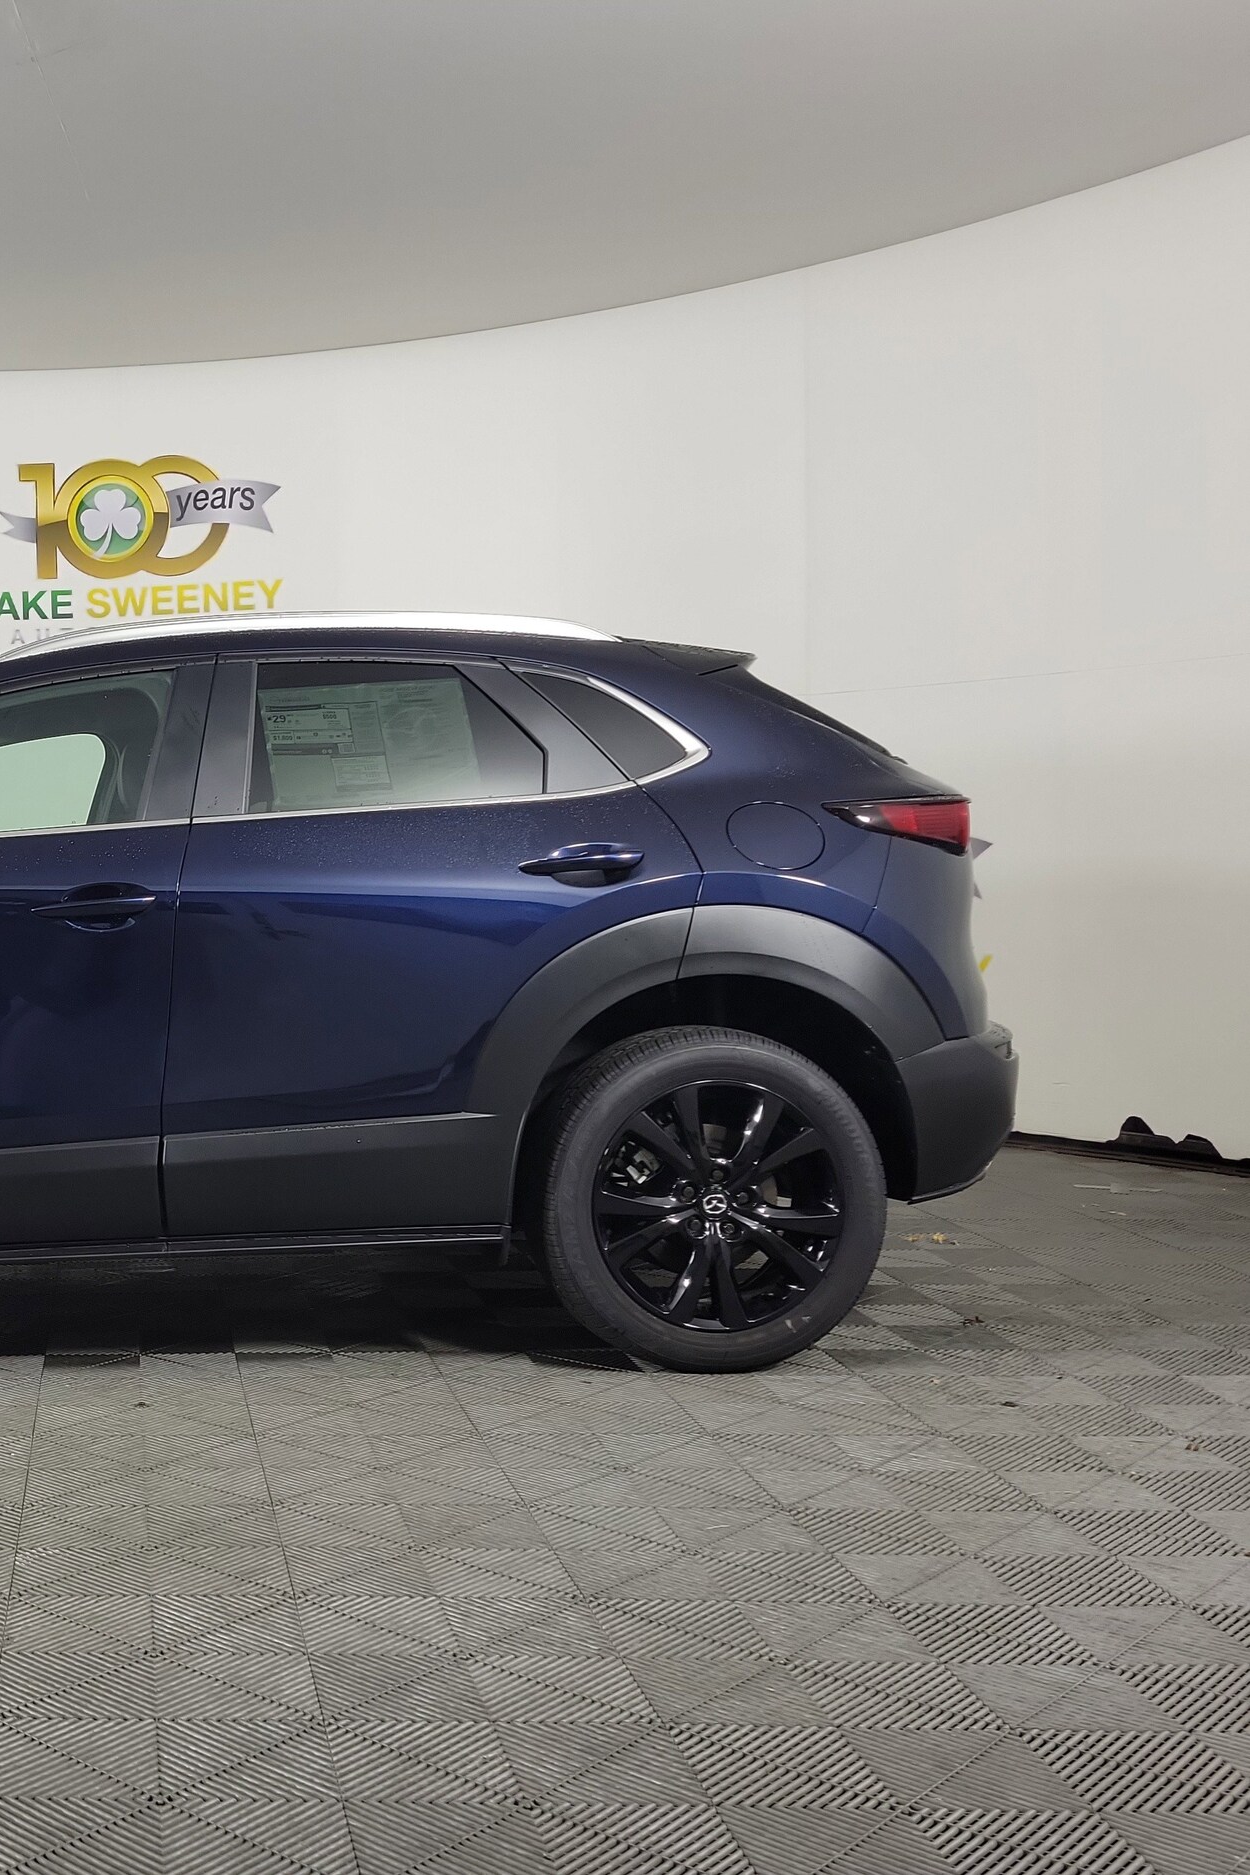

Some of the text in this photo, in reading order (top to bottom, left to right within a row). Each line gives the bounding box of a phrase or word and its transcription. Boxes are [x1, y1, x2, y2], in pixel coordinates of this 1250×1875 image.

[17, 455, 230, 580] 100
[176, 484, 256, 521] years
[86, 579, 284, 619] SWEENEY
[272, 714, 287, 724] 29
